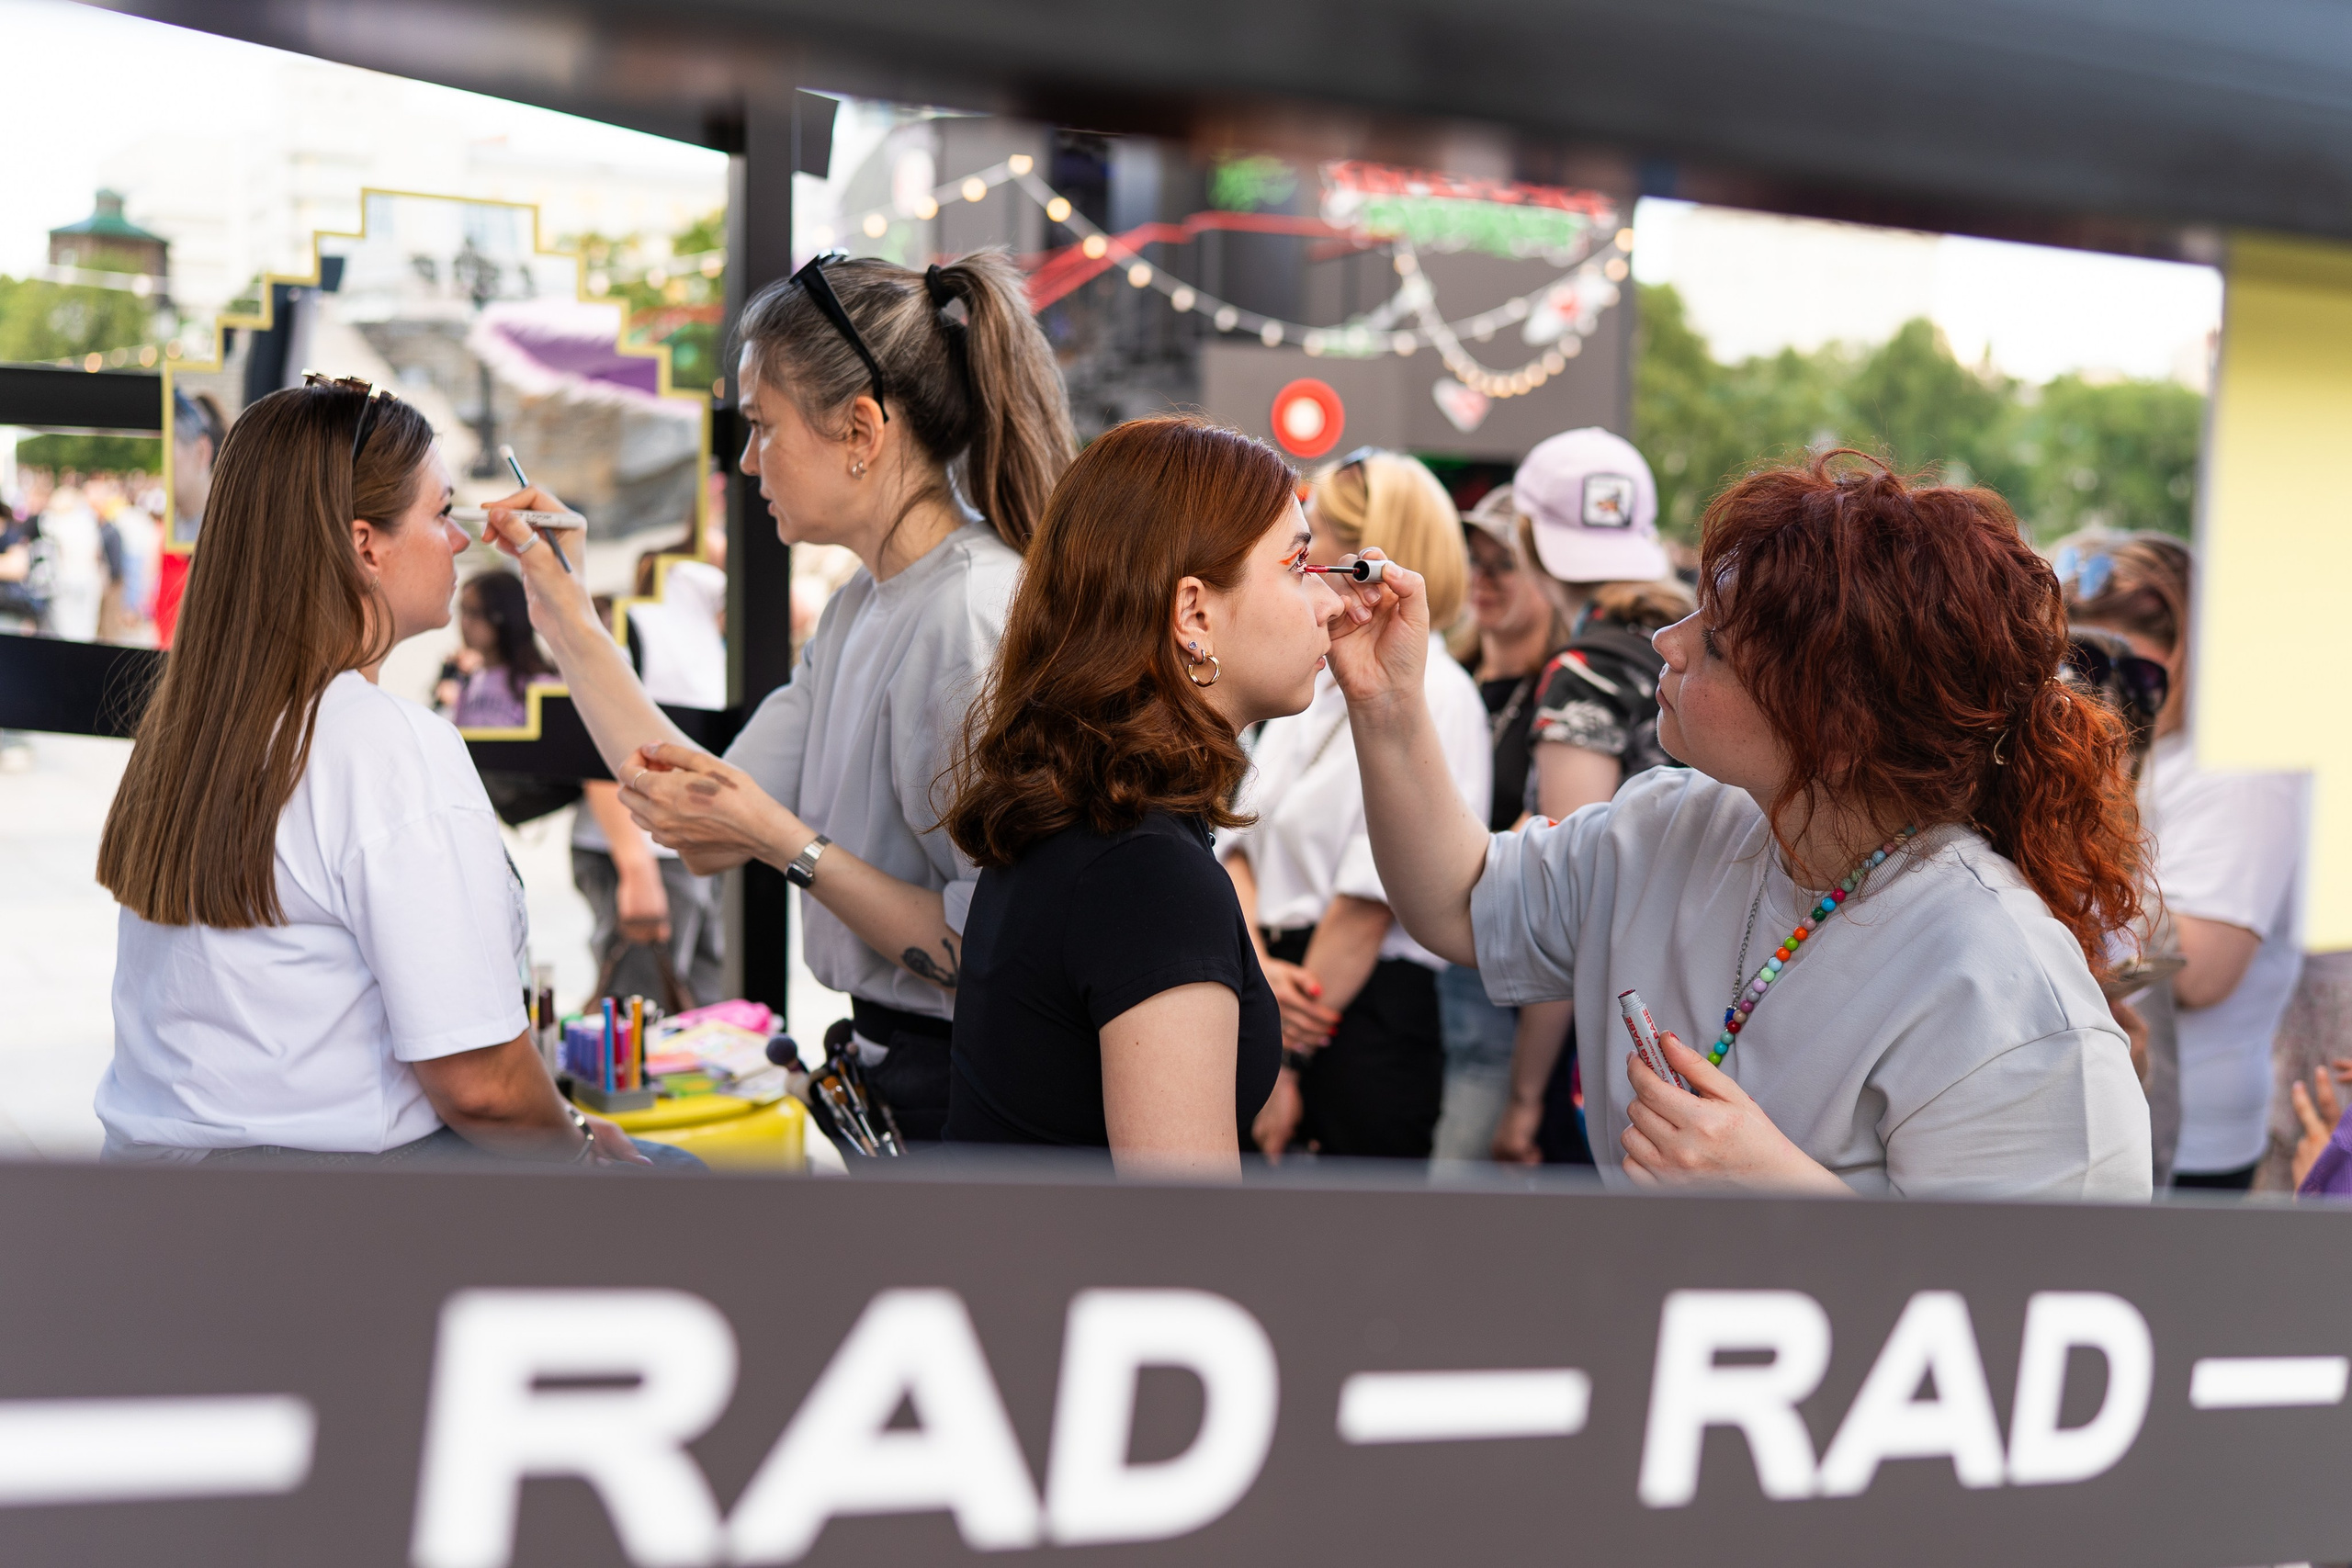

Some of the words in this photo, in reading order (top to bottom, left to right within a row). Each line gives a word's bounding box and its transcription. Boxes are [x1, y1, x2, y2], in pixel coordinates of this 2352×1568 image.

[1625, 1016, 1644, 1047] BABE
[1642, 1008, 1659, 1040] BABE
[407, 1287, 1279, 1568] RAD
[1639, 1290, 2154, 1508] RAD
